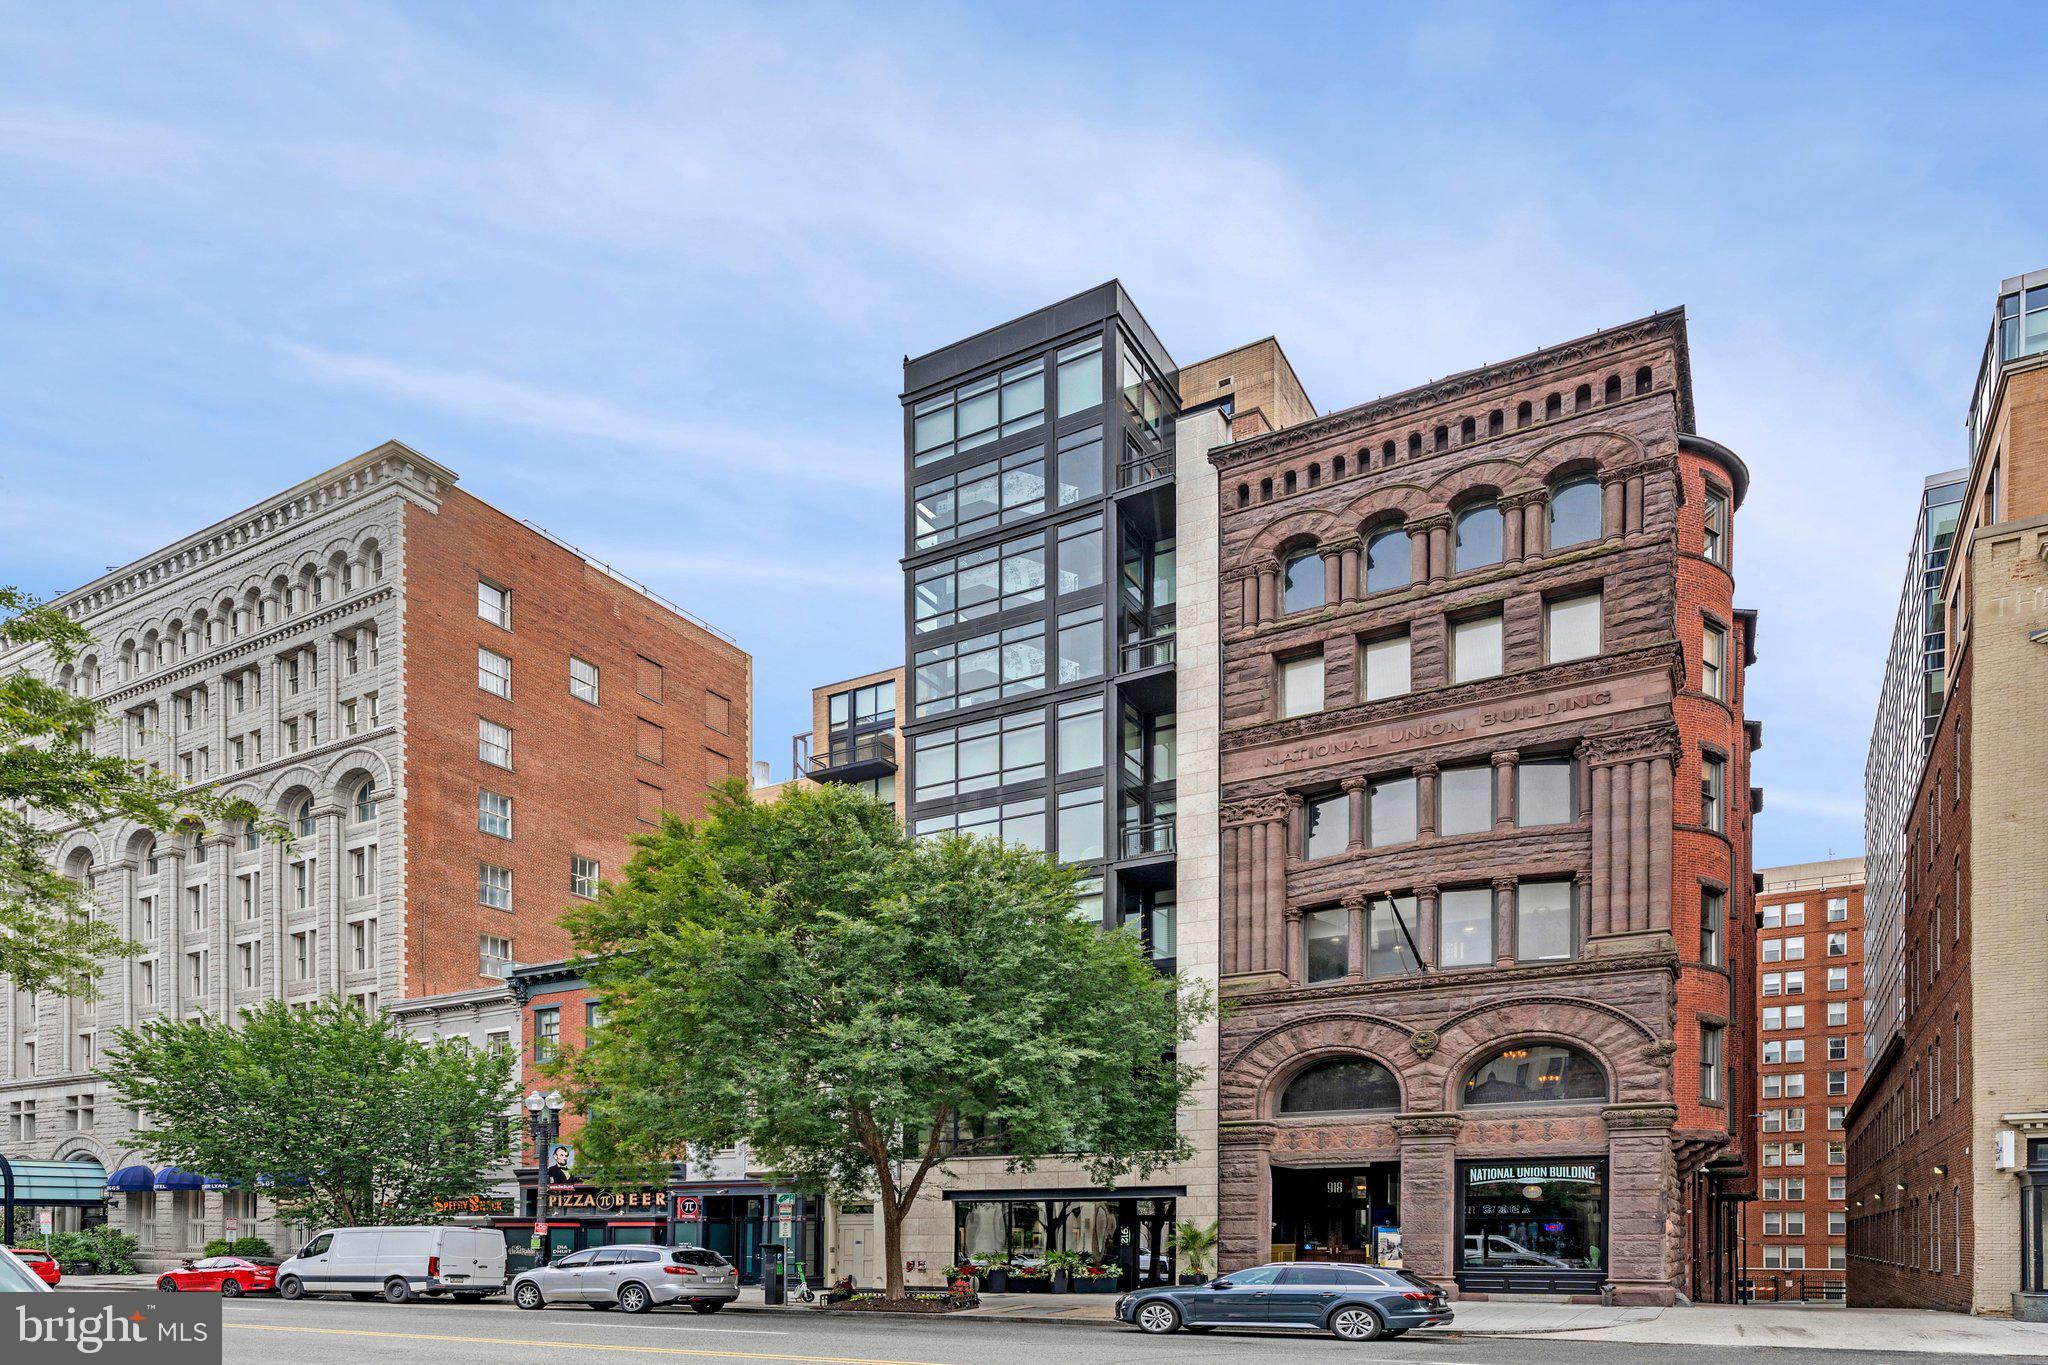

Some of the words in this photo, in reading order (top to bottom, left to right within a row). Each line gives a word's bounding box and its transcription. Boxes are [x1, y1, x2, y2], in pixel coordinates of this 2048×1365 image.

[1263, 734, 1378, 768] NATIONAL
[1388, 718, 1466, 744] UNION
[1480, 690, 1612, 727] BUILDING
[1470, 1167, 1515, 1182] NATIONAL
[1516, 1167, 1547, 1178] UNION
[1549, 1166, 1596, 1180] BUILDING
[1327, 1182, 1343, 1194] 918
[549, 1194, 596, 1207] PIZZA
[615, 1192, 667, 1207] BEER
[1120, 1228, 1129, 1244] 912
